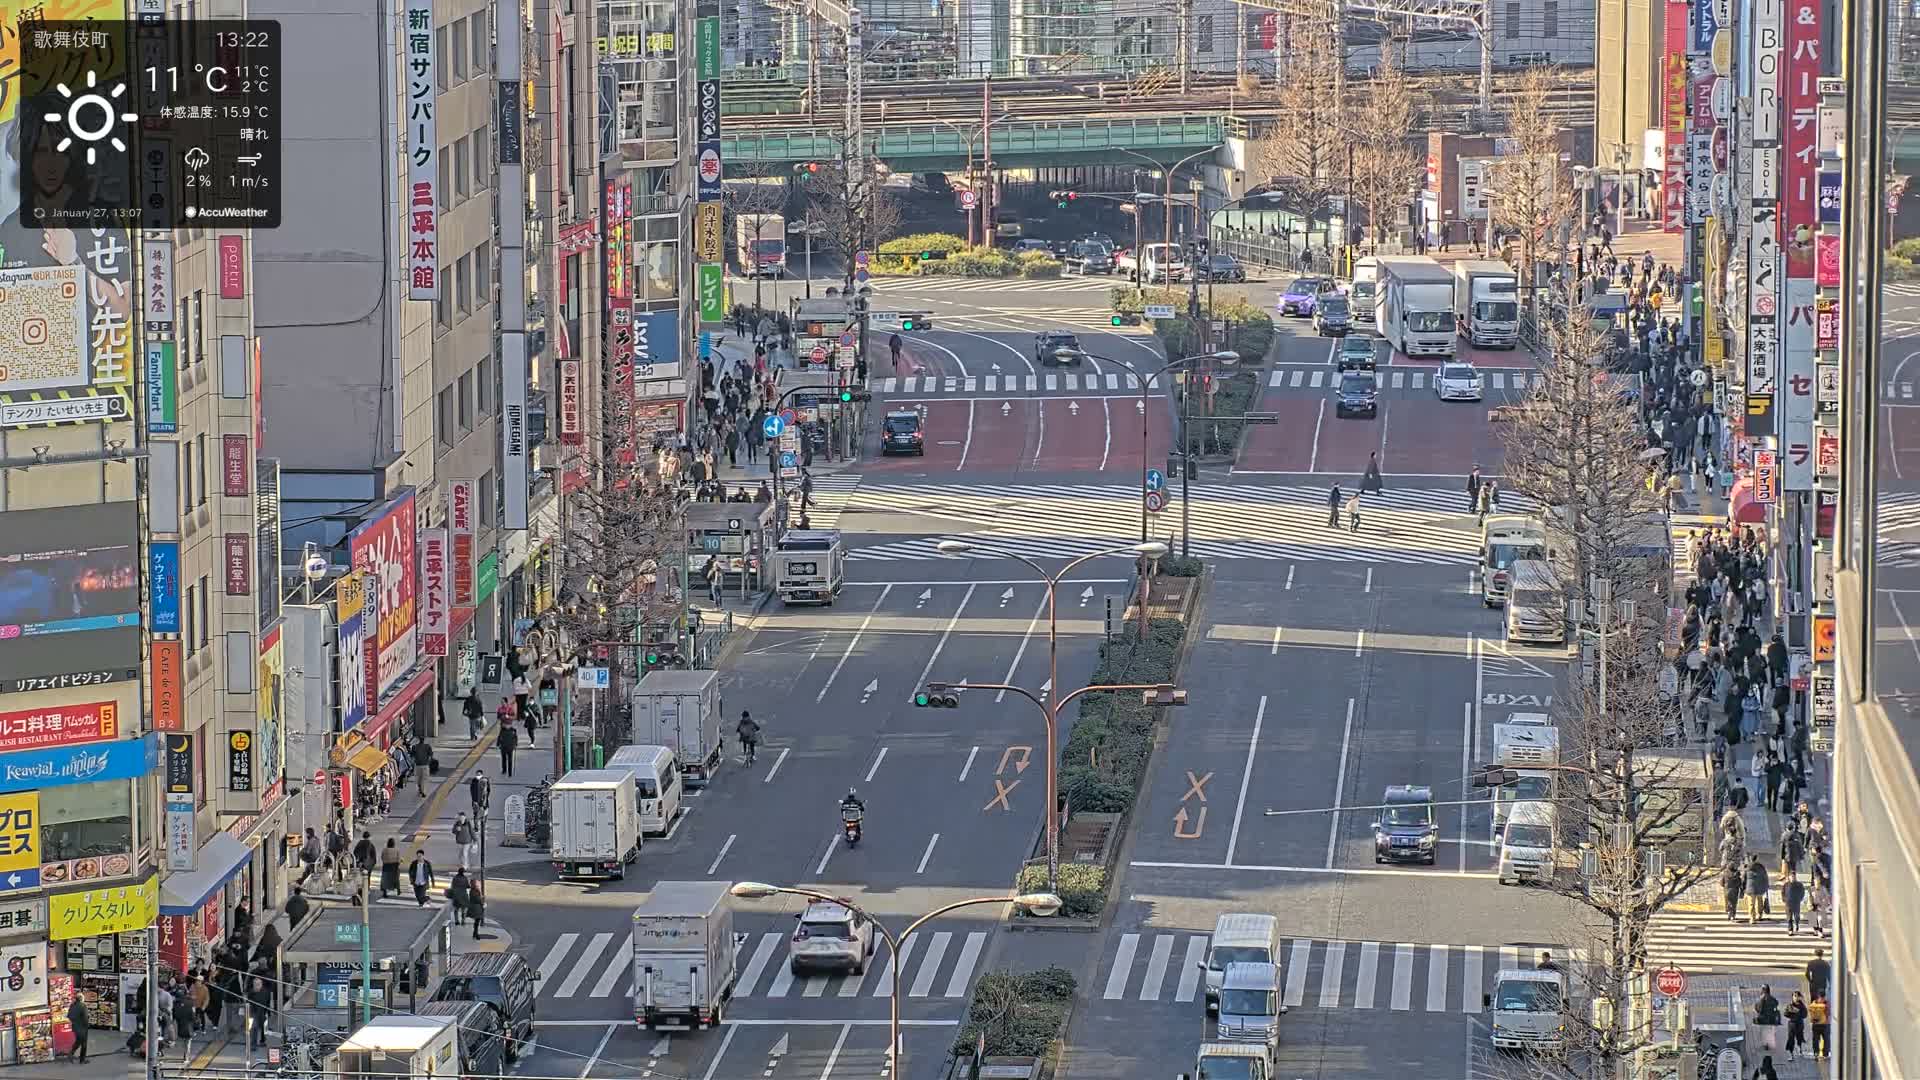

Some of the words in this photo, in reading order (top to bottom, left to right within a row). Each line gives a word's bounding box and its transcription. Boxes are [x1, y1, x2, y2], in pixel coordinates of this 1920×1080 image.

[408, 8, 433, 167] 新宿サンパーク
[1699, 84, 1711, 118] アコム
[701, 158, 718, 175] 薬
[1762, 149, 1770, 197] ESOLA
[411, 182, 435, 289] 三平本館
[703, 205, 717, 260] 肉汁水餃子
[703, 273, 717, 311] レイク
[1752, 327, 1767, 379] 大衆酒場
[150, 351, 161, 412] FamilyMart
[1788, 305, 1815, 467] パセラ
[47, 404, 104, 417] たいせい先生
[506, 404, 521, 457] HOMEGAME
[454, 484, 465, 529] GAME
[706, 539, 720, 549] 10
[154, 552, 164, 604] ゲウチャイ
[425, 540, 443, 627] 三平ストア
[16, 671, 113, 692] リアエイドビジョン
[18, 733, 62, 744] RESTAURANT
[0, 909, 32, 929] 囲碁
[63, 900, 136, 925] クリスタル
[321, 988, 336, 1002] 12
